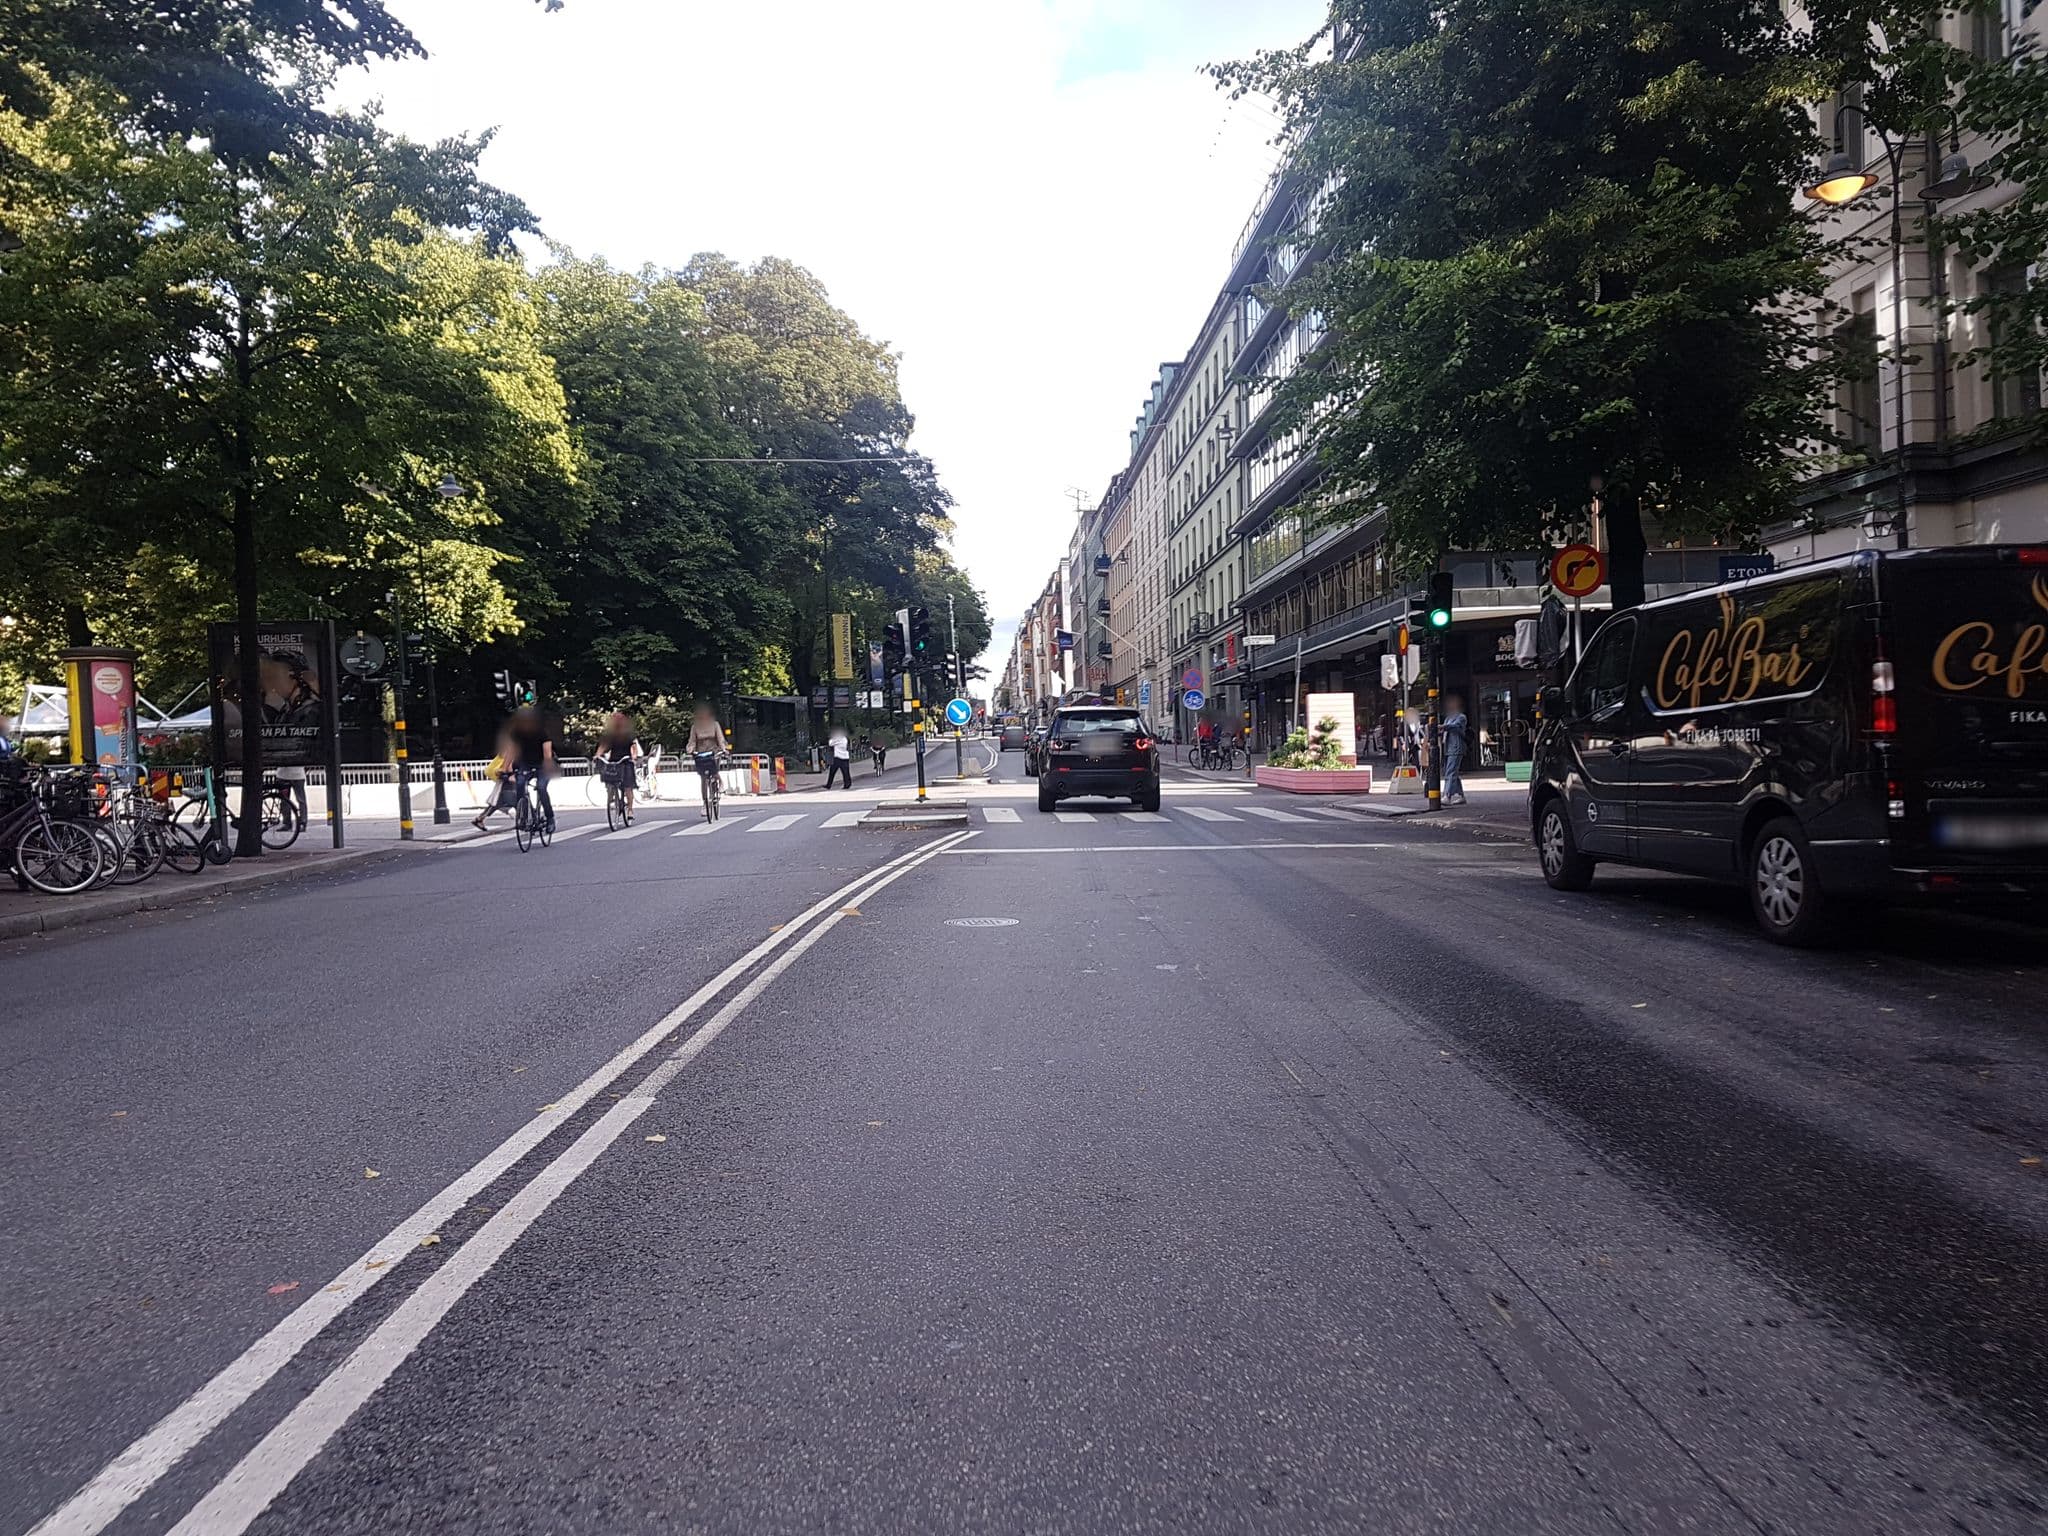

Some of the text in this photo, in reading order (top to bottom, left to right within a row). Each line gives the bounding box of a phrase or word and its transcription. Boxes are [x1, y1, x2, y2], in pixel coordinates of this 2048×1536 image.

[1728, 567, 1768, 579] ETON
[842, 615, 851, 668] FINNKAMPEN
[1932, 621, 2048, 698] Caf
[2010, 711, 2048, 722] FIKA
[275, 726, 287, 737] PÅ
[289, 726, 320, 737] TAKET
[1722, 727, 1761, 743] JOBBET!
